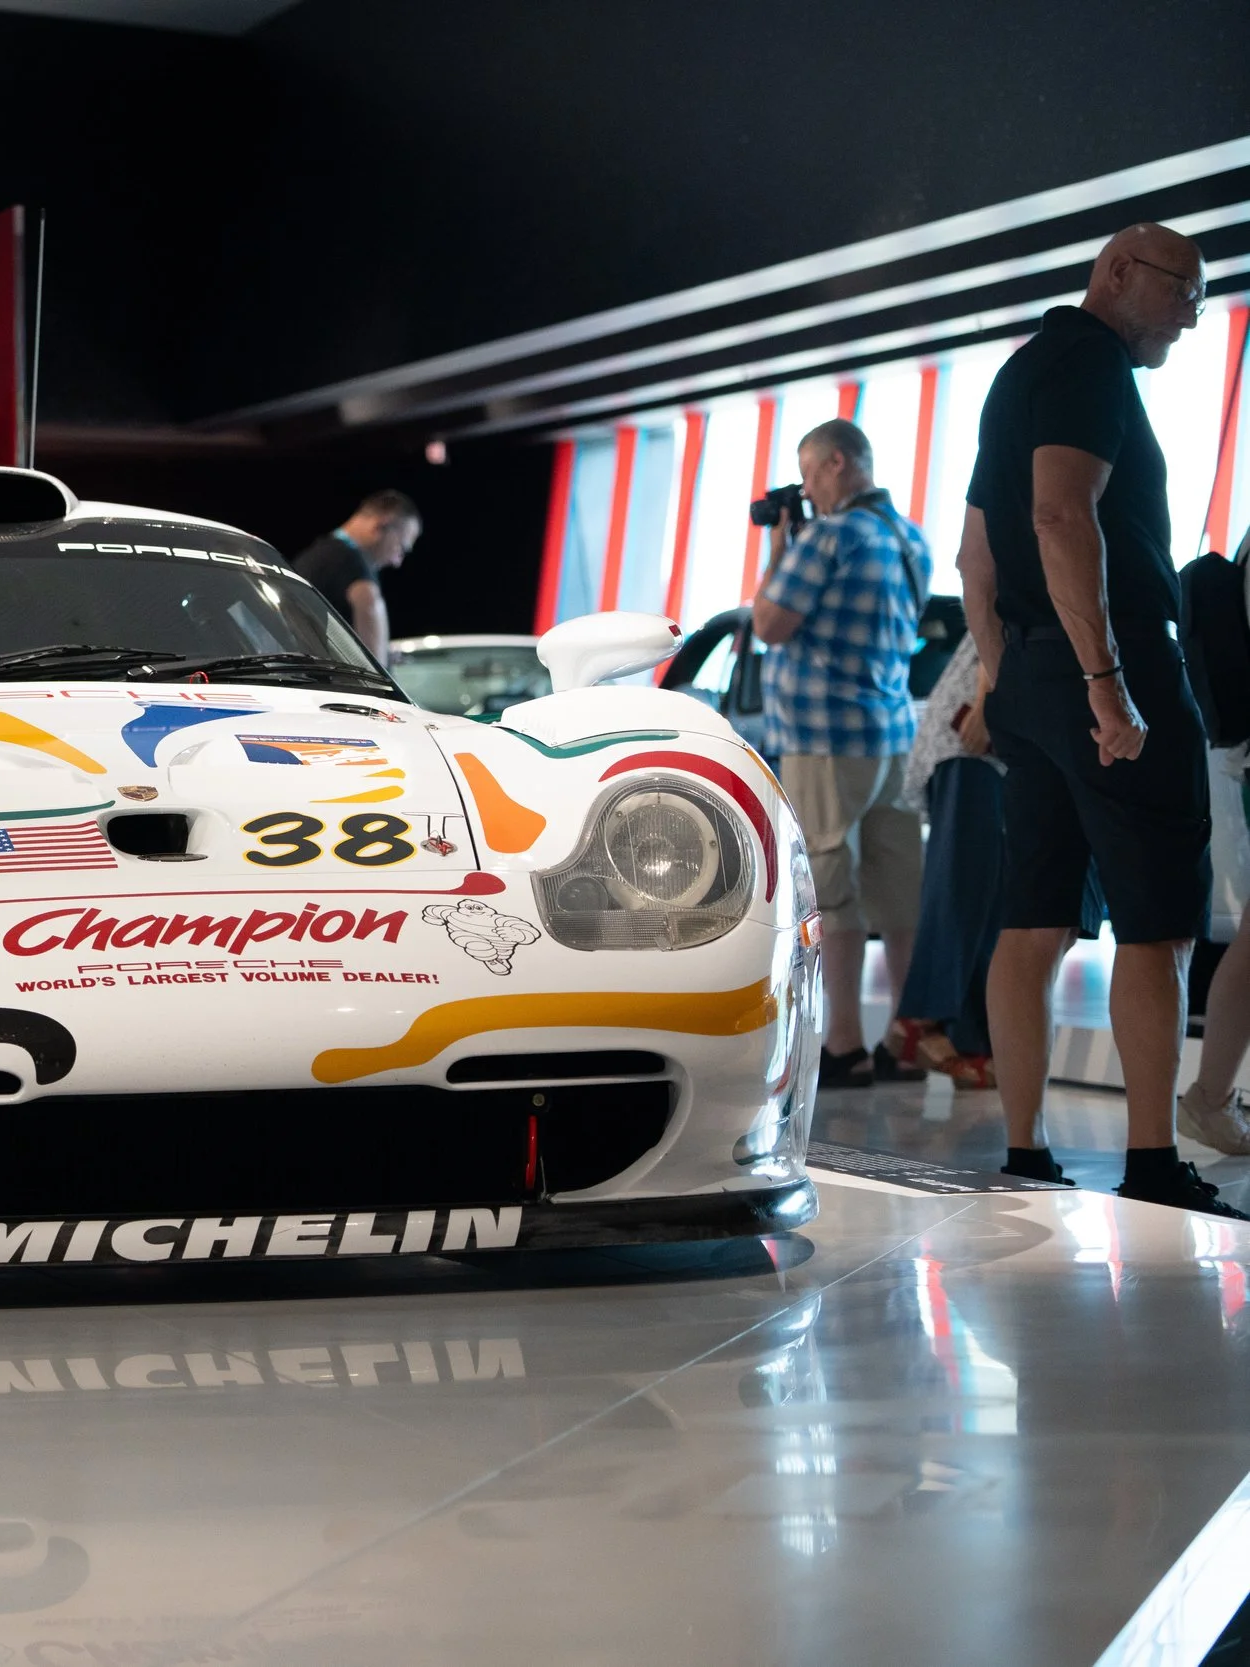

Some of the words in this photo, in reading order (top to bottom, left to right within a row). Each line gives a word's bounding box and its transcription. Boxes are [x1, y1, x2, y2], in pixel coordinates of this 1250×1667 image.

[240, 811, 418, 868] 38
[2, 902, 410, 957] Champion
[15, 975, 117, 993] WORLD'S
[128, 972, 229, 986] LARGEST
[240, 971, 332, 984] VOLUME
[342, 972, 441, 986] DEALER!
[77, 959, 345, 974] PORSCHE
